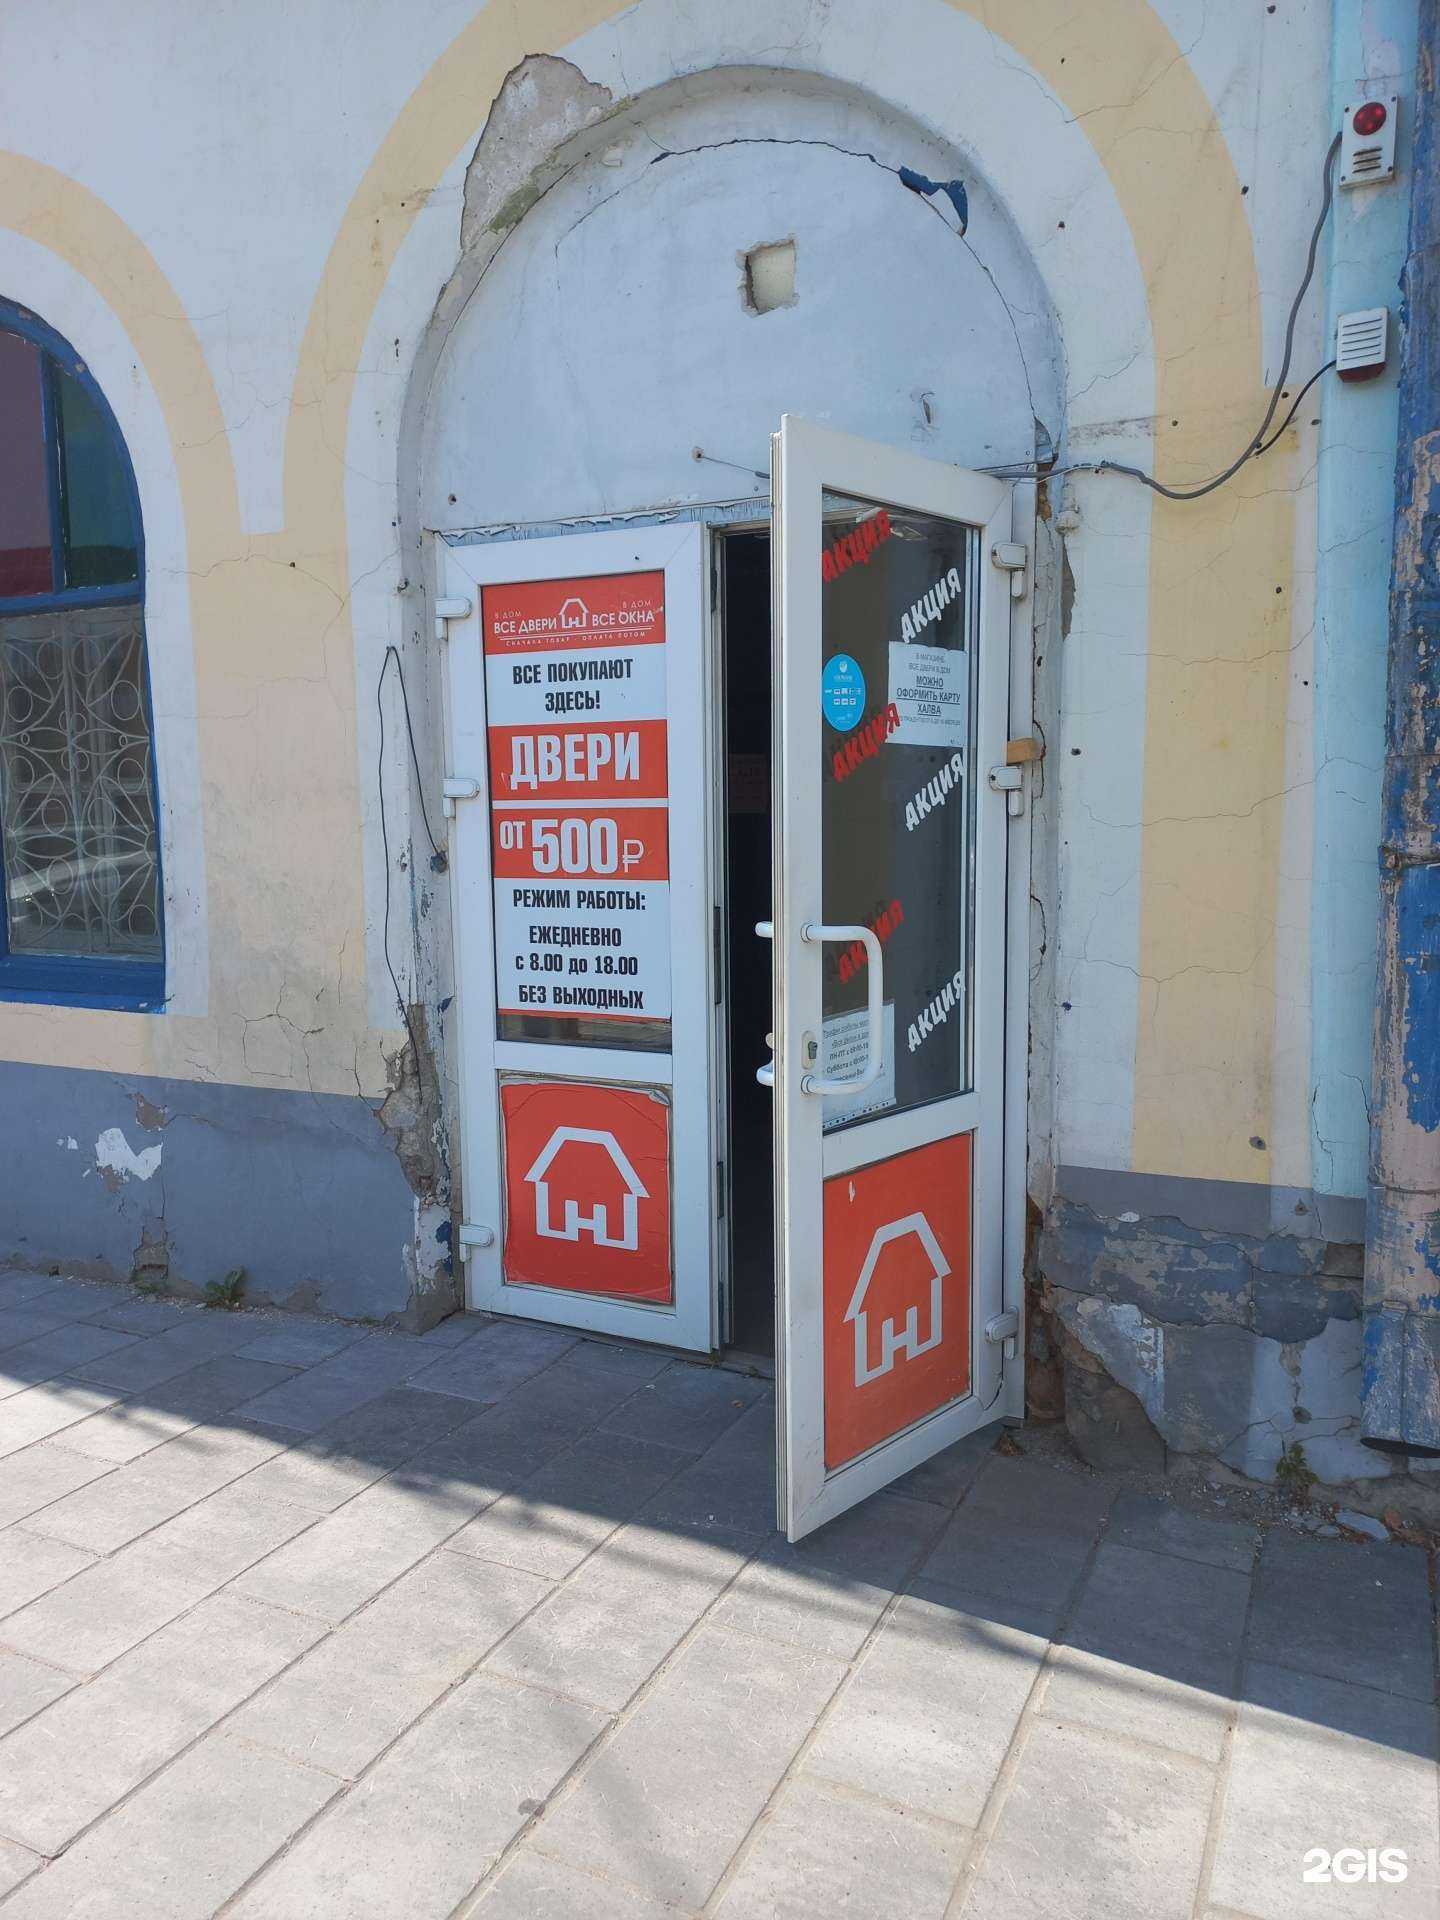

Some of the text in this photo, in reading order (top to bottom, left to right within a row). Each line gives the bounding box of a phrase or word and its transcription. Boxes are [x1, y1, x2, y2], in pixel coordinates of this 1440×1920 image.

[822, 508, 892, 583] АКЦИЯ
[503, 610, 521, 620] ДОМ
[631, 600, 651, 609] ДОМ
[901, 567, 962, 643] АКЦИЯ
[494, 617, 557, 634] ВСЕ ДВЕРИ
[592, 609, 655, 627] ВСЕ ОКНА
[512, 659, 633, 684] ВСЕ ПОКУПАЮТ
[916, 675, 944, 688] МОЖНО
[545, 690, 600, 713] ЗДЕСЬ!
[896, 688, 961, 703] ОФОРМИТЬ КАРТУ
[917, 703, 941, 715] ХАЛВА
[832, 703, 901, 783] АКЦИЯ
[510, 731, 640, 790] ДВЕРИ
[905, 752, 965, 832] АКЦИЯ
[499, 820, 526, 850] ОТ
[513, 889, 646, 911] РЕЖИМ РАБОТЫ:
[529, 925, 622, 948] ЕЖЕДНЕВНО
[840, 900, 904, 984] АКИЯ
[529, 953, 563, 972] 8.00
[568, 957, 588, 974] до
[594, 956, 638, 976] 18.00
[518, 984, 644, 1010] БЕЗ ВЫХОДНЫХ
[907, 970, 967, 1052] АКЦИЯ
